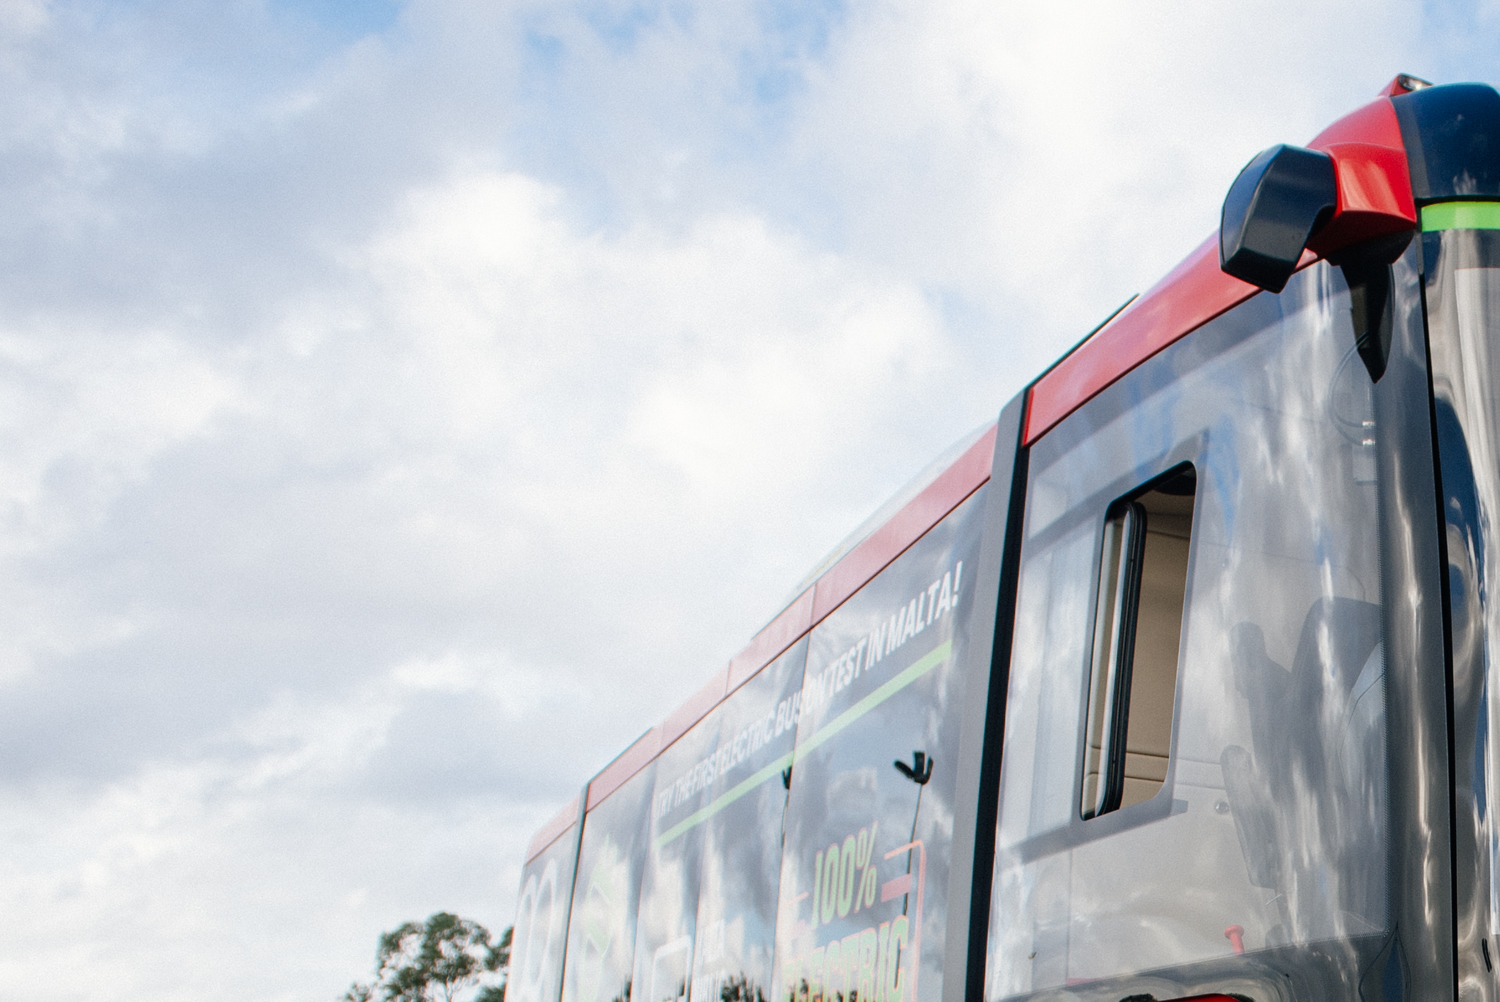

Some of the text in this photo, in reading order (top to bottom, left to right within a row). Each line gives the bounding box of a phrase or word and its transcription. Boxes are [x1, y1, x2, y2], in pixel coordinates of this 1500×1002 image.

[718, 709, 776, 776] ELECTRIC
[774, 689, 804, 738] BUS
[828, 636, 867, 697] TEST
[864, 621, 887, 671] IN
[886, 560, 963, 657] MALTA!
[811, 820, 878, 931] 100%
